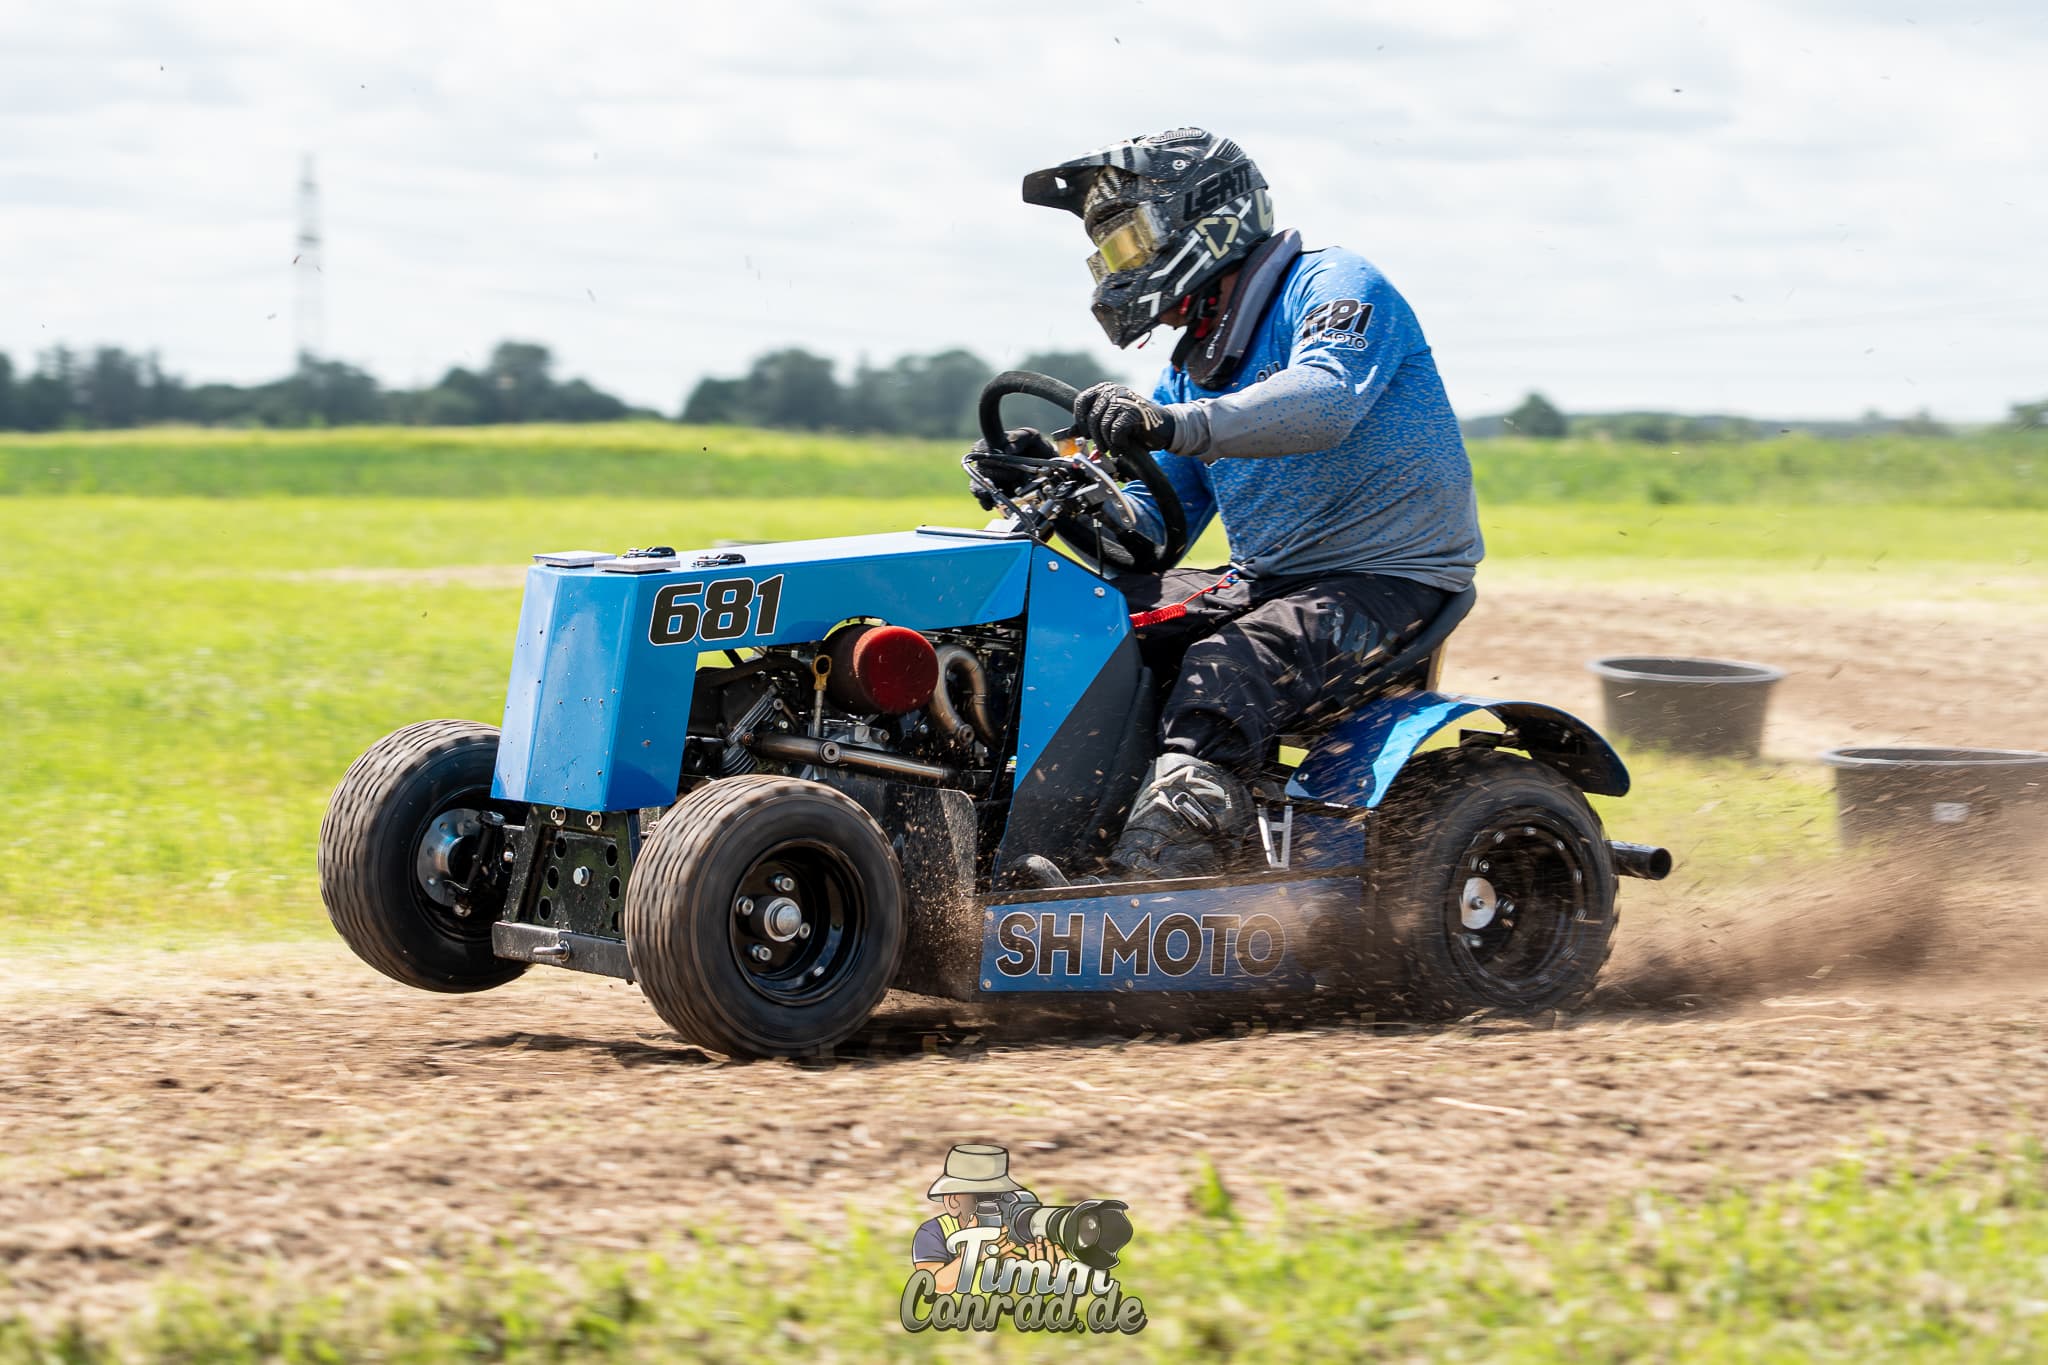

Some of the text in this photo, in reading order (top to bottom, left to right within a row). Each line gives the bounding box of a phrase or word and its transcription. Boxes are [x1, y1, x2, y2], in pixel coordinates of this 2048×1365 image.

[1320, 332, 1367, 349] MOTO
[648, 574, 784, 647] 681
[995, 911, 1287, 977] SH MOTO
